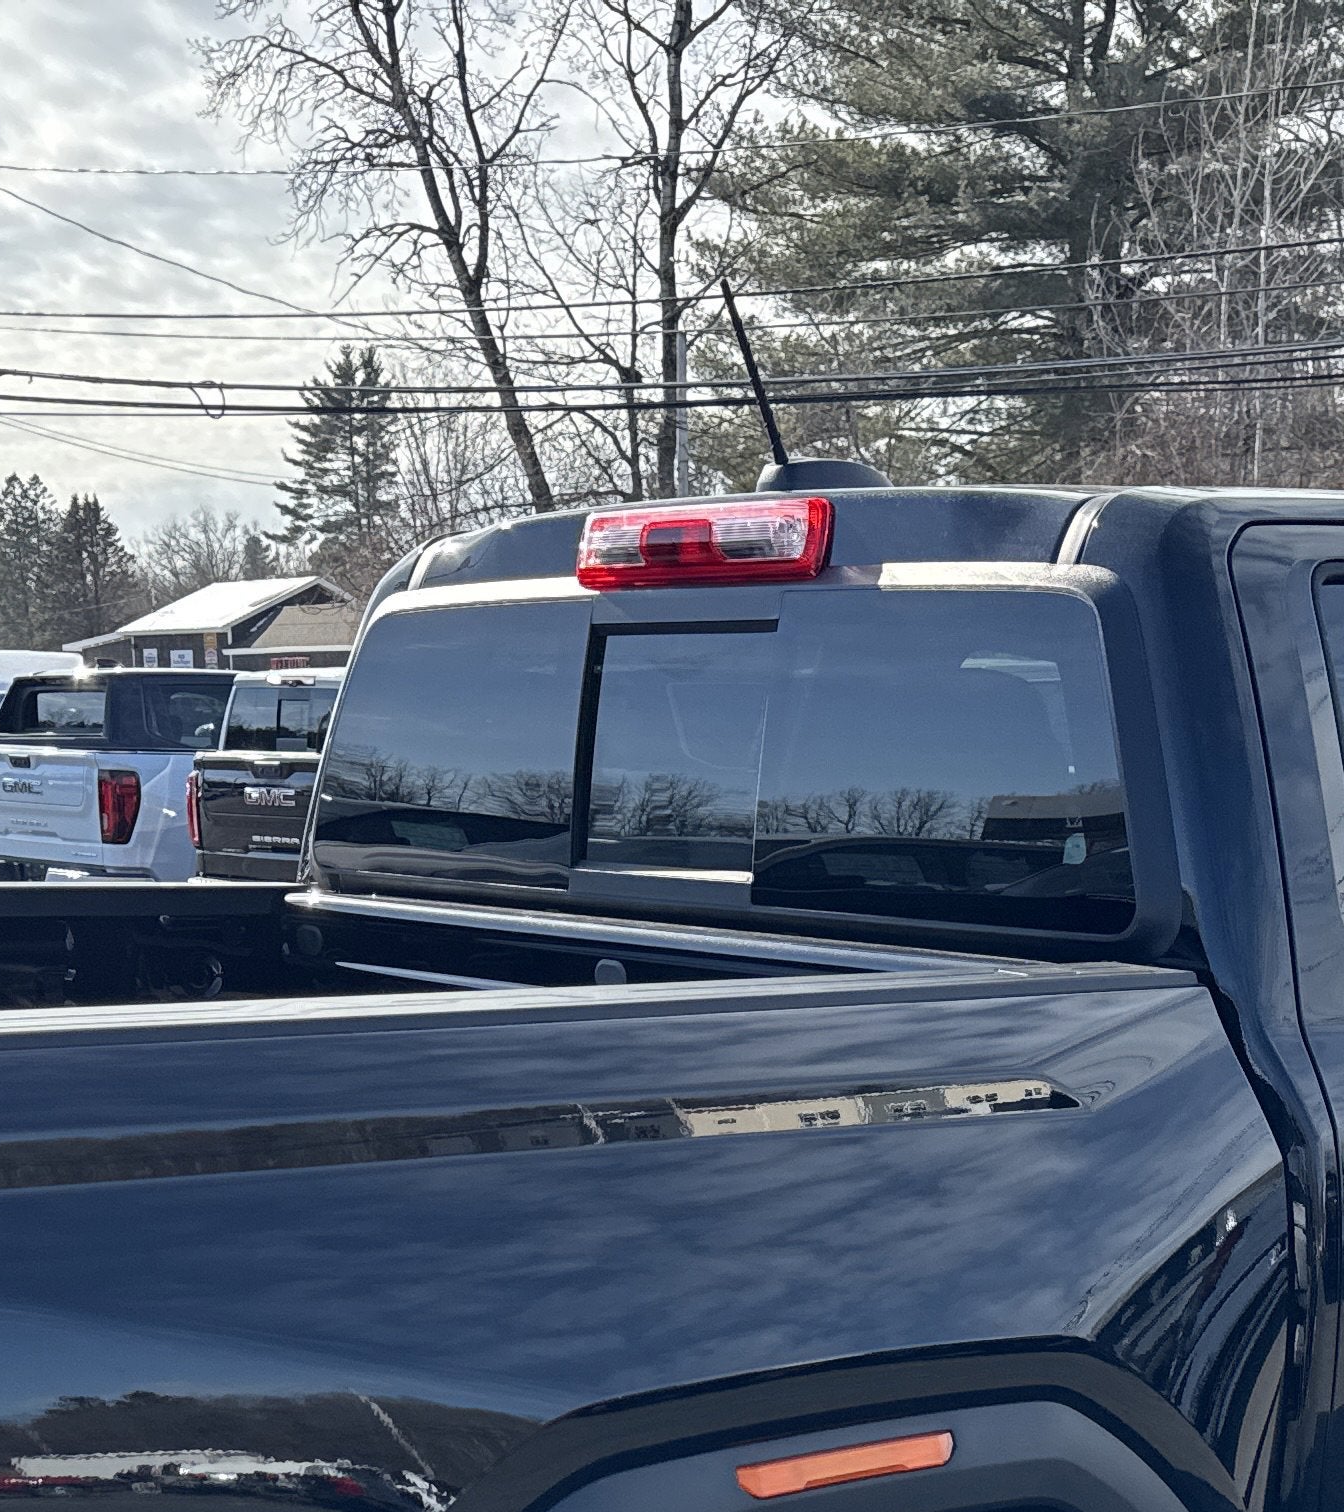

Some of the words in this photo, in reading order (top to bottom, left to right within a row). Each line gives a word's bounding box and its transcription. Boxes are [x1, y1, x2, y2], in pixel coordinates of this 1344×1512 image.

[2, 777, 44, 796] GMC
[244, 786, 296, 807] GMC
[251, 835, 301, 845] SIERRA
